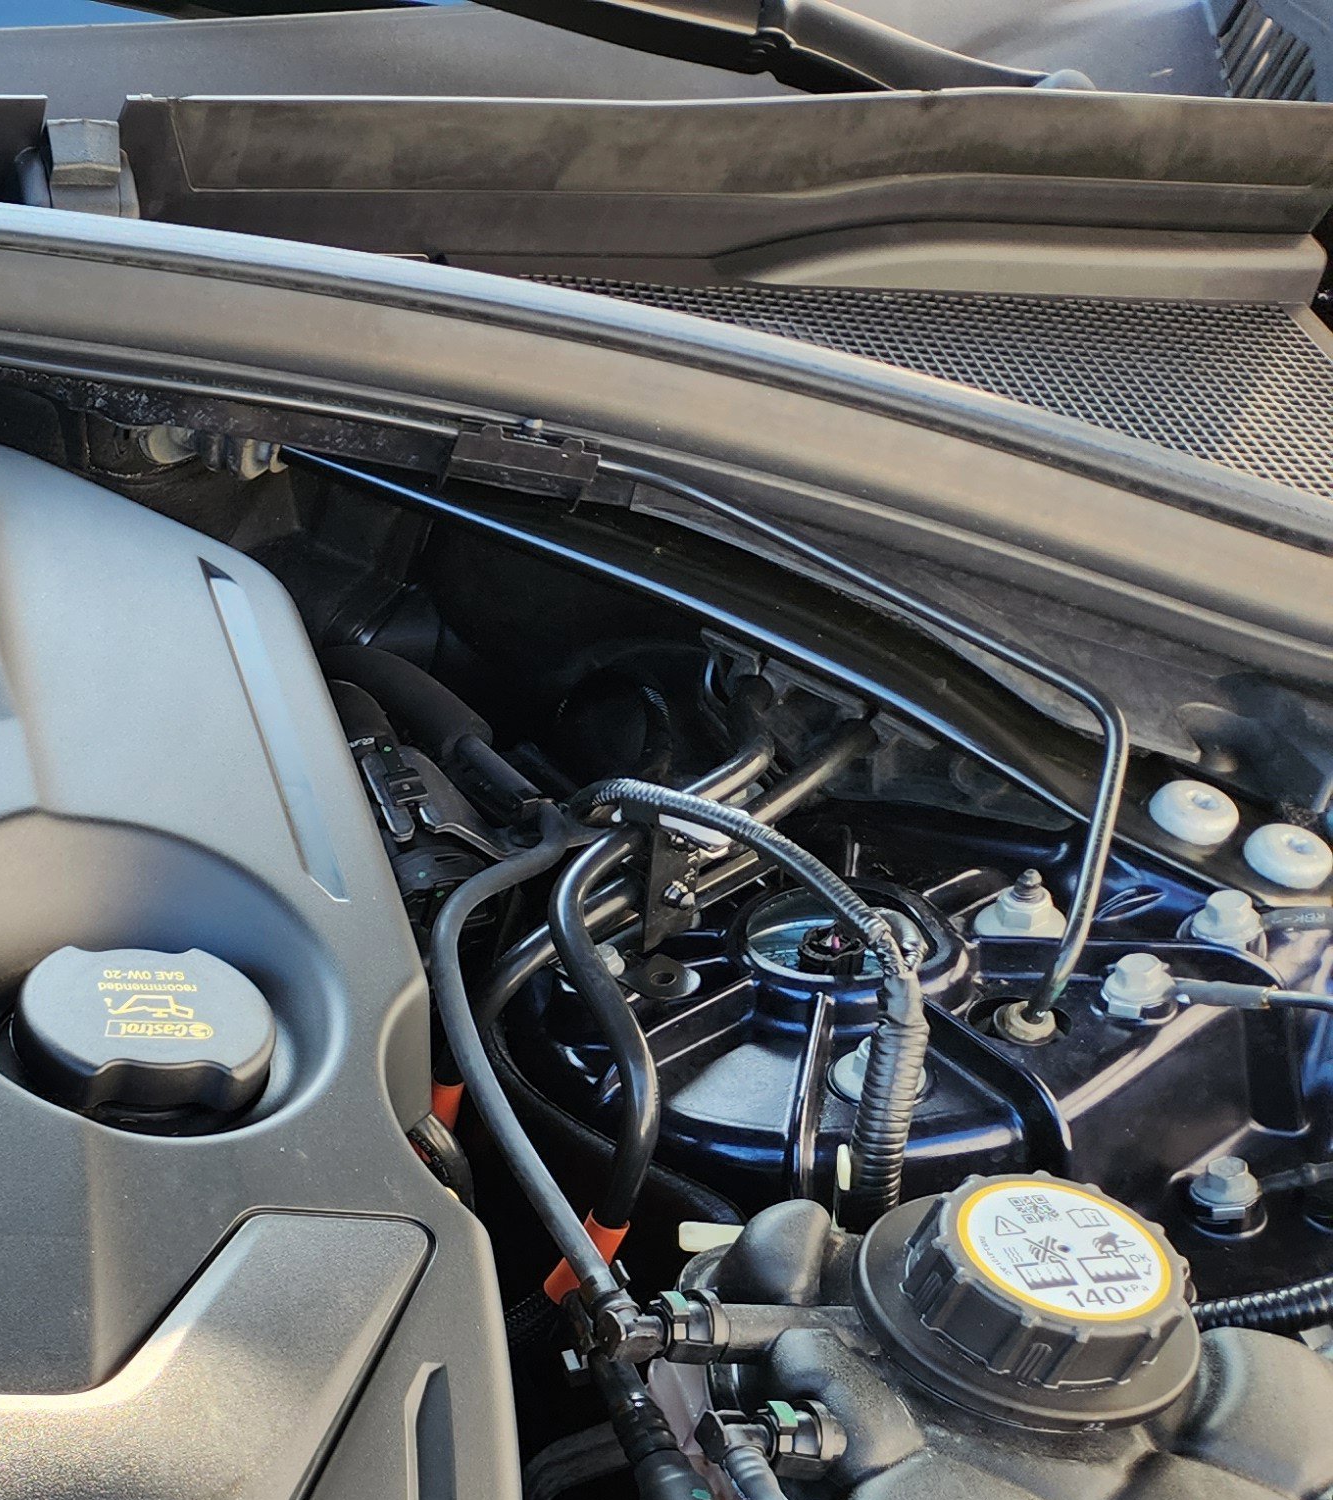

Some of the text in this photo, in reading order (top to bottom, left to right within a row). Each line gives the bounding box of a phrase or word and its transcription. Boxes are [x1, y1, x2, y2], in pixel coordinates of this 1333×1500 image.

[103, 969, 185, 981] SAE 0W-20
[98, 982, 197, 993] recommended
[119, 1023, 188, 1037] Castrol
[1129, 1253, 1152, 1265] OK
[1066, 1285, 1126, 1308] 140
